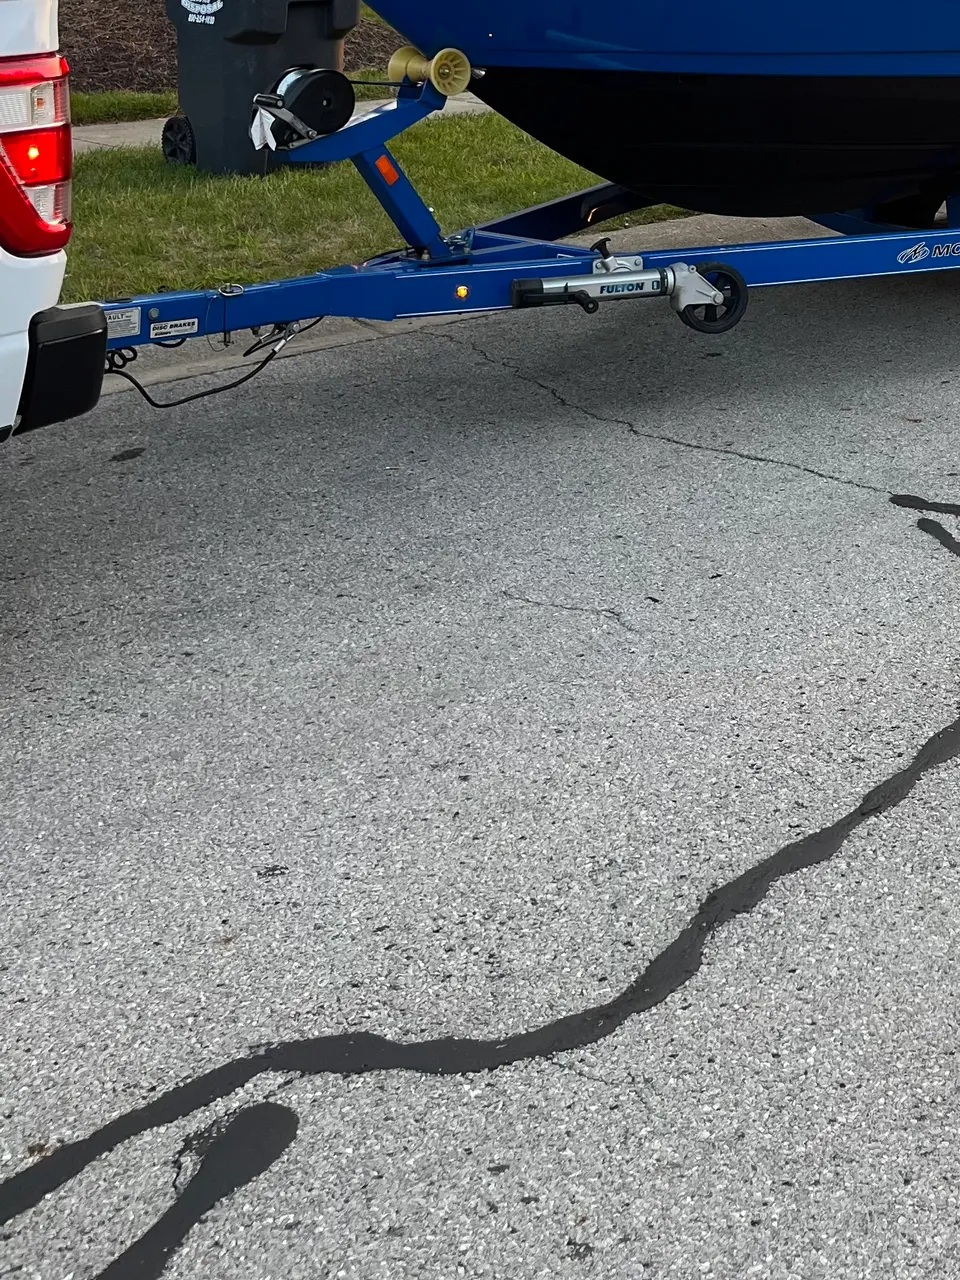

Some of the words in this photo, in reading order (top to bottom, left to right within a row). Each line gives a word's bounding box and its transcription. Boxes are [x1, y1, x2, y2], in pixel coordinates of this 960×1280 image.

[181, 0, 223, 15] DISPOSAL
[600, 282, 645, 294] FULTON
[169, 321, 196, 330] BRAKES
